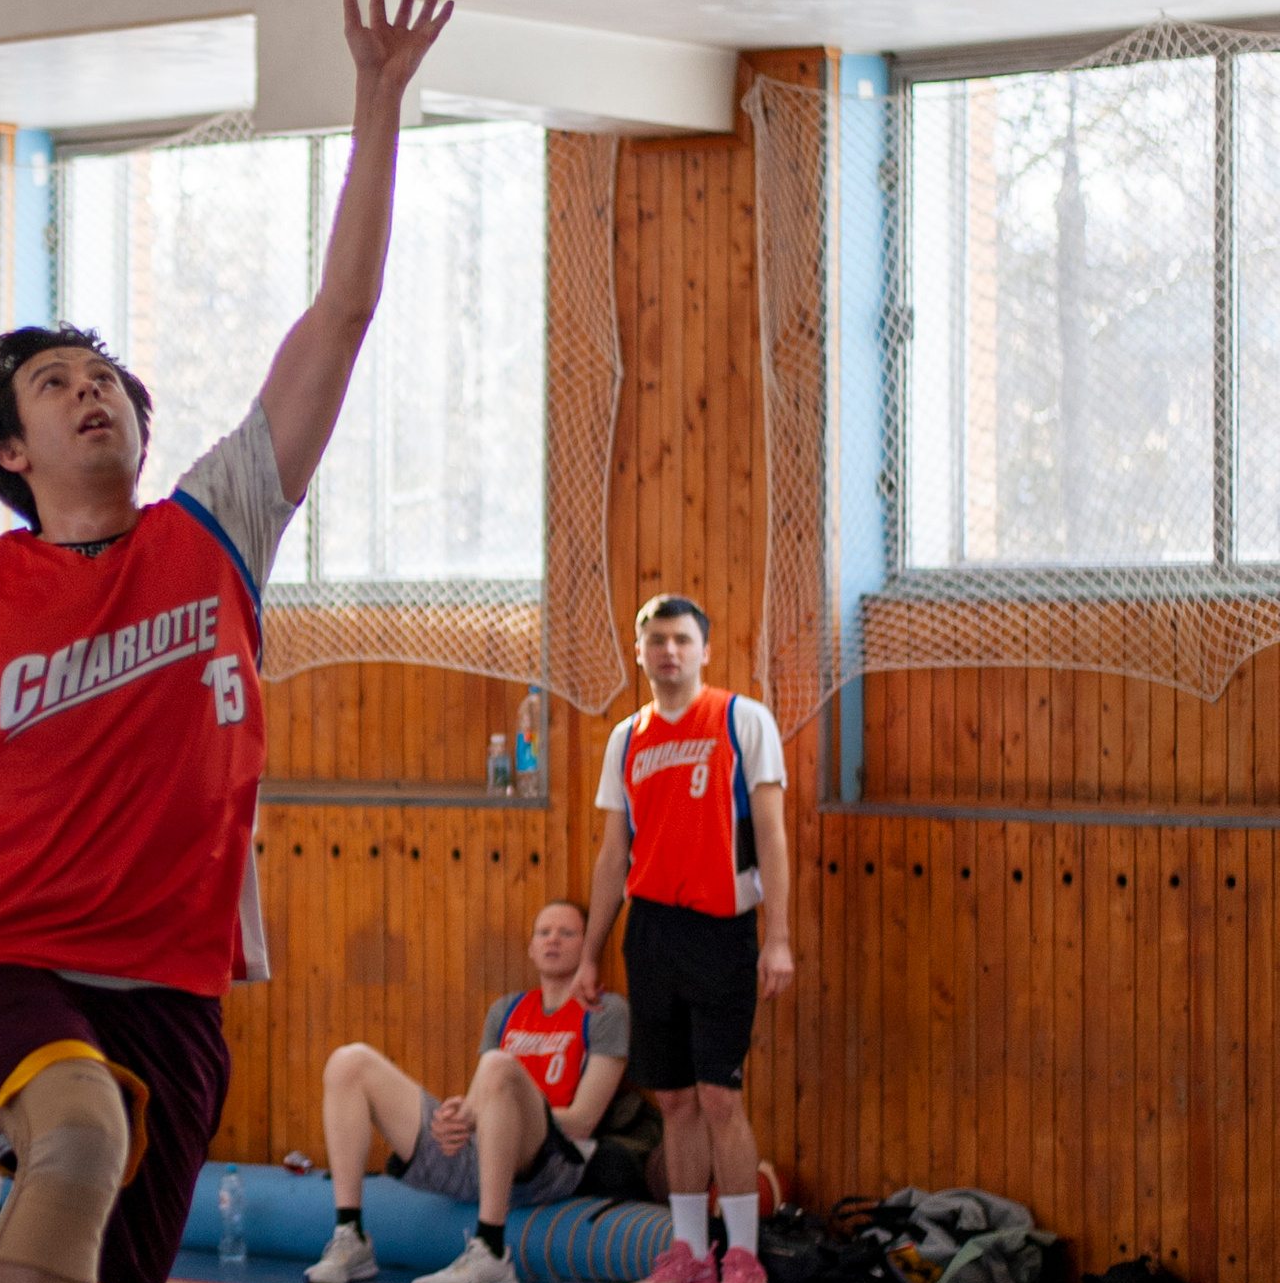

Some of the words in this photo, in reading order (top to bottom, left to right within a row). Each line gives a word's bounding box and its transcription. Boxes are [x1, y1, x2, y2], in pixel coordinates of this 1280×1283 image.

[200, 654, 246, 726] 15
[689, 763, 710, 799] 9
[544, 1053, 567, 1086] 0
